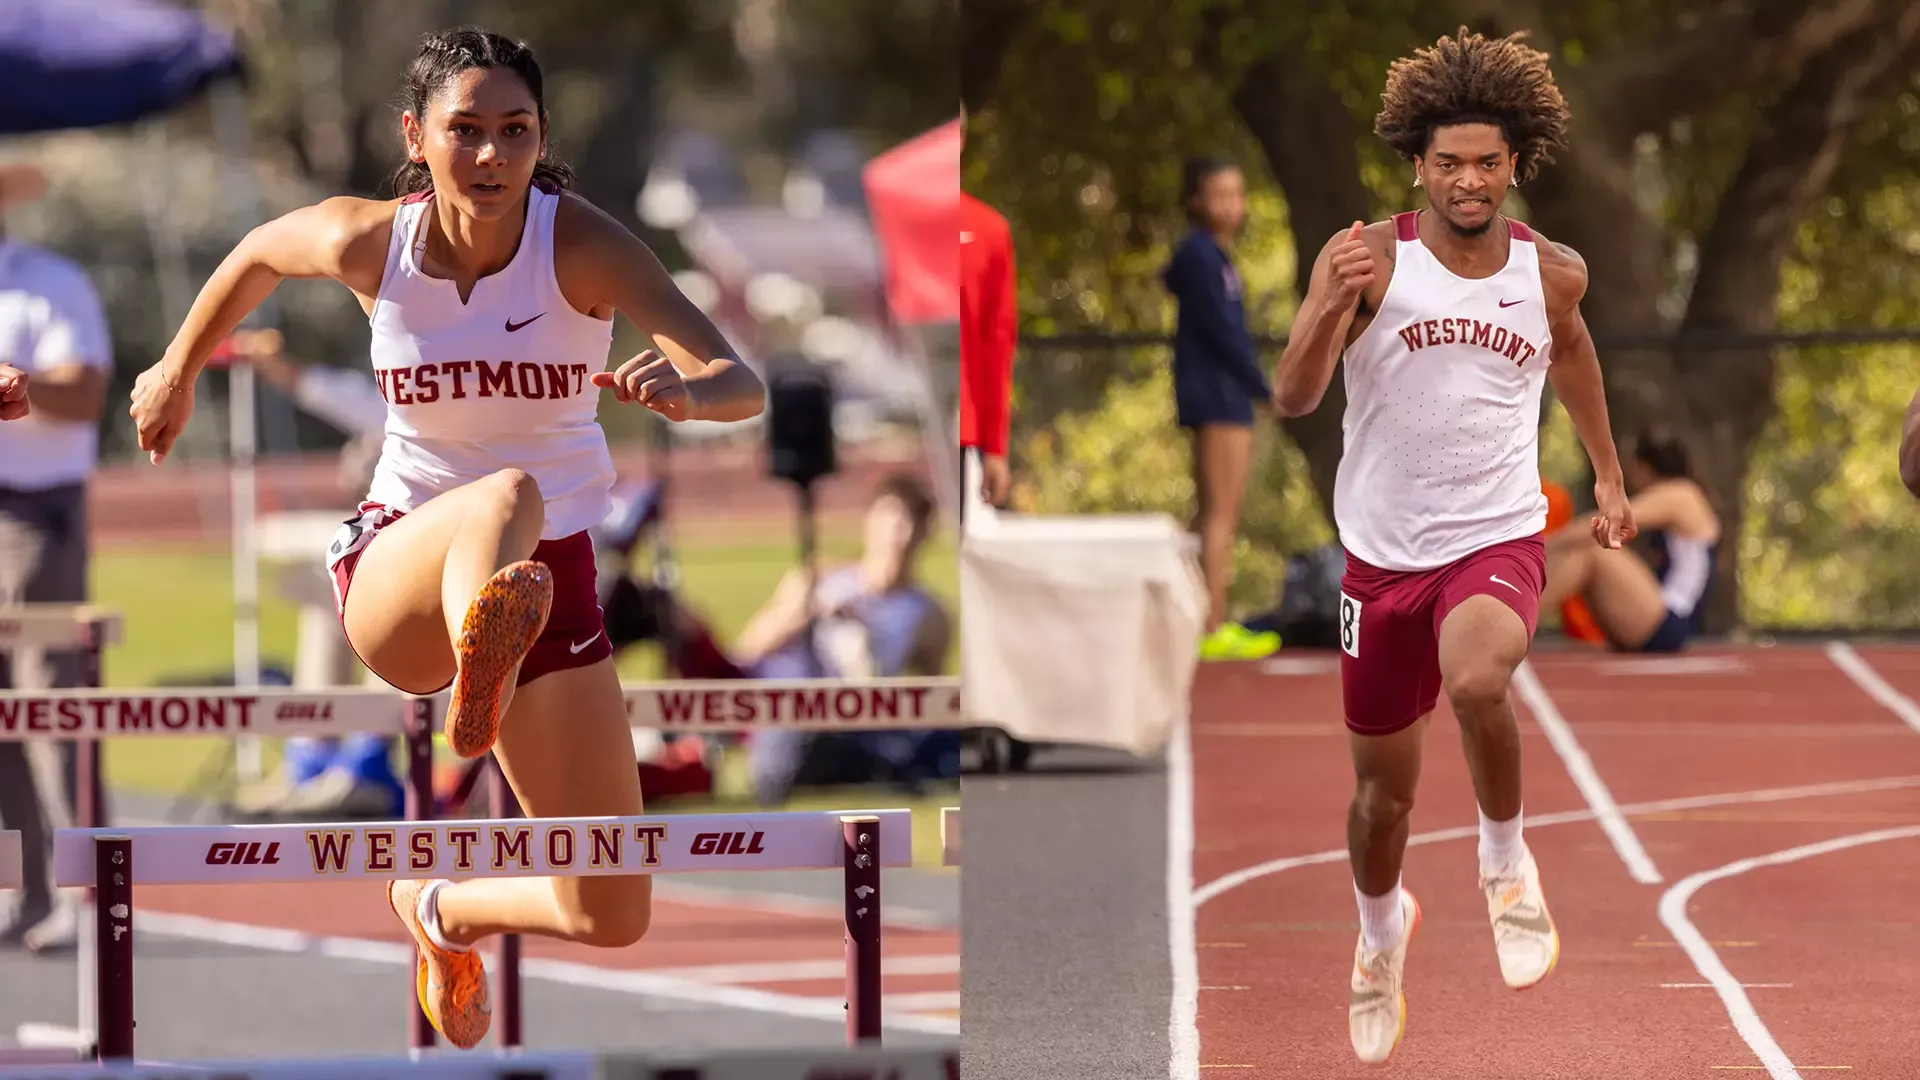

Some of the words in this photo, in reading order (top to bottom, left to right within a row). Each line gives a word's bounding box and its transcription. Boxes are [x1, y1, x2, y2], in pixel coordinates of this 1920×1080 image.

[1398, 318, 1536, 367] WESTMONT
[1343, 598, 1354, 651] 8
[656, 687, 929, 722] WESTMONT
[205, 842, 281, 865] GILL
[306, 823, 668, 874] WESTMONT
[690, 831, 765, 856] GILL
